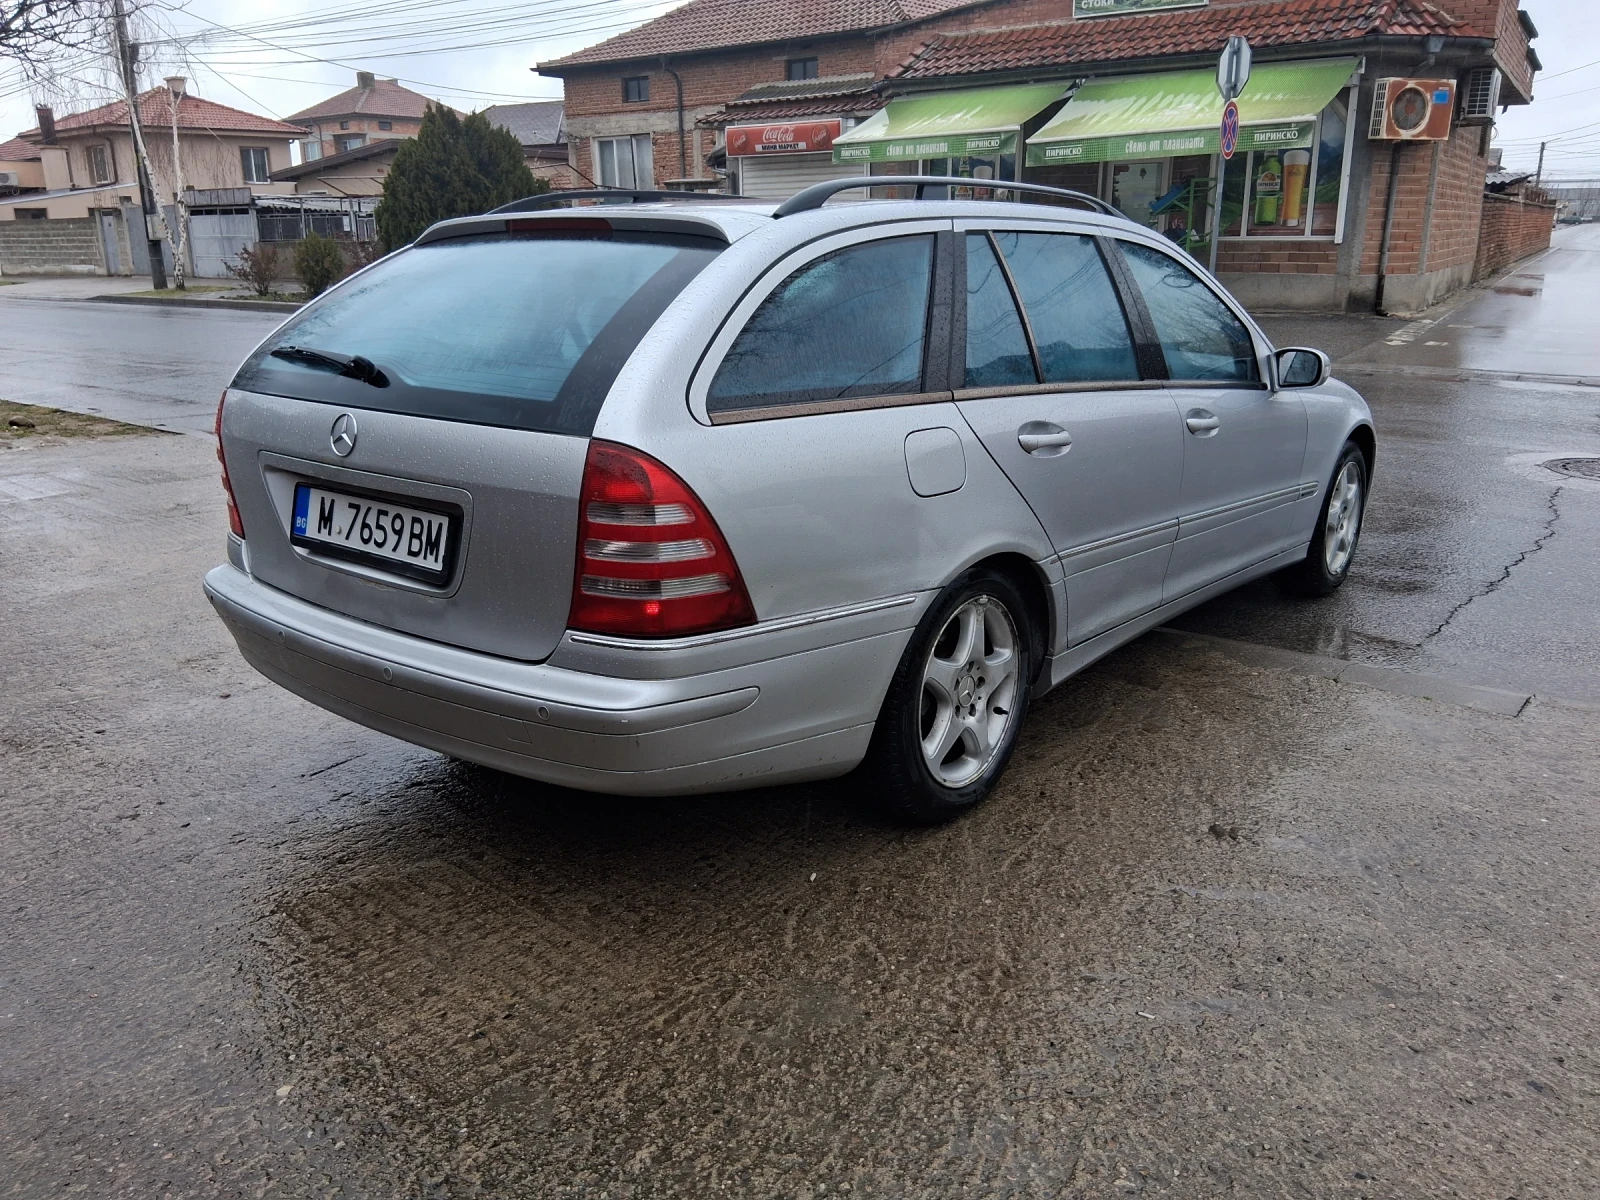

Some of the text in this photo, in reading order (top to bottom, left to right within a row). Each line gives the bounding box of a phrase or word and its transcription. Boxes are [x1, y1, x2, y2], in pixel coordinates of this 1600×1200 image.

[1254, 130, 1298, 142] ПИРИНСКО
[966, 139, 1000, 149] ПИРИНСКО
[1149, 140, 1160, 151] от
[840, 148, 871, 158] ПИРИНСКО
[1045, 146, 1082, 157] ПИРИНСКО
[296, 516, 307, 529] BG
